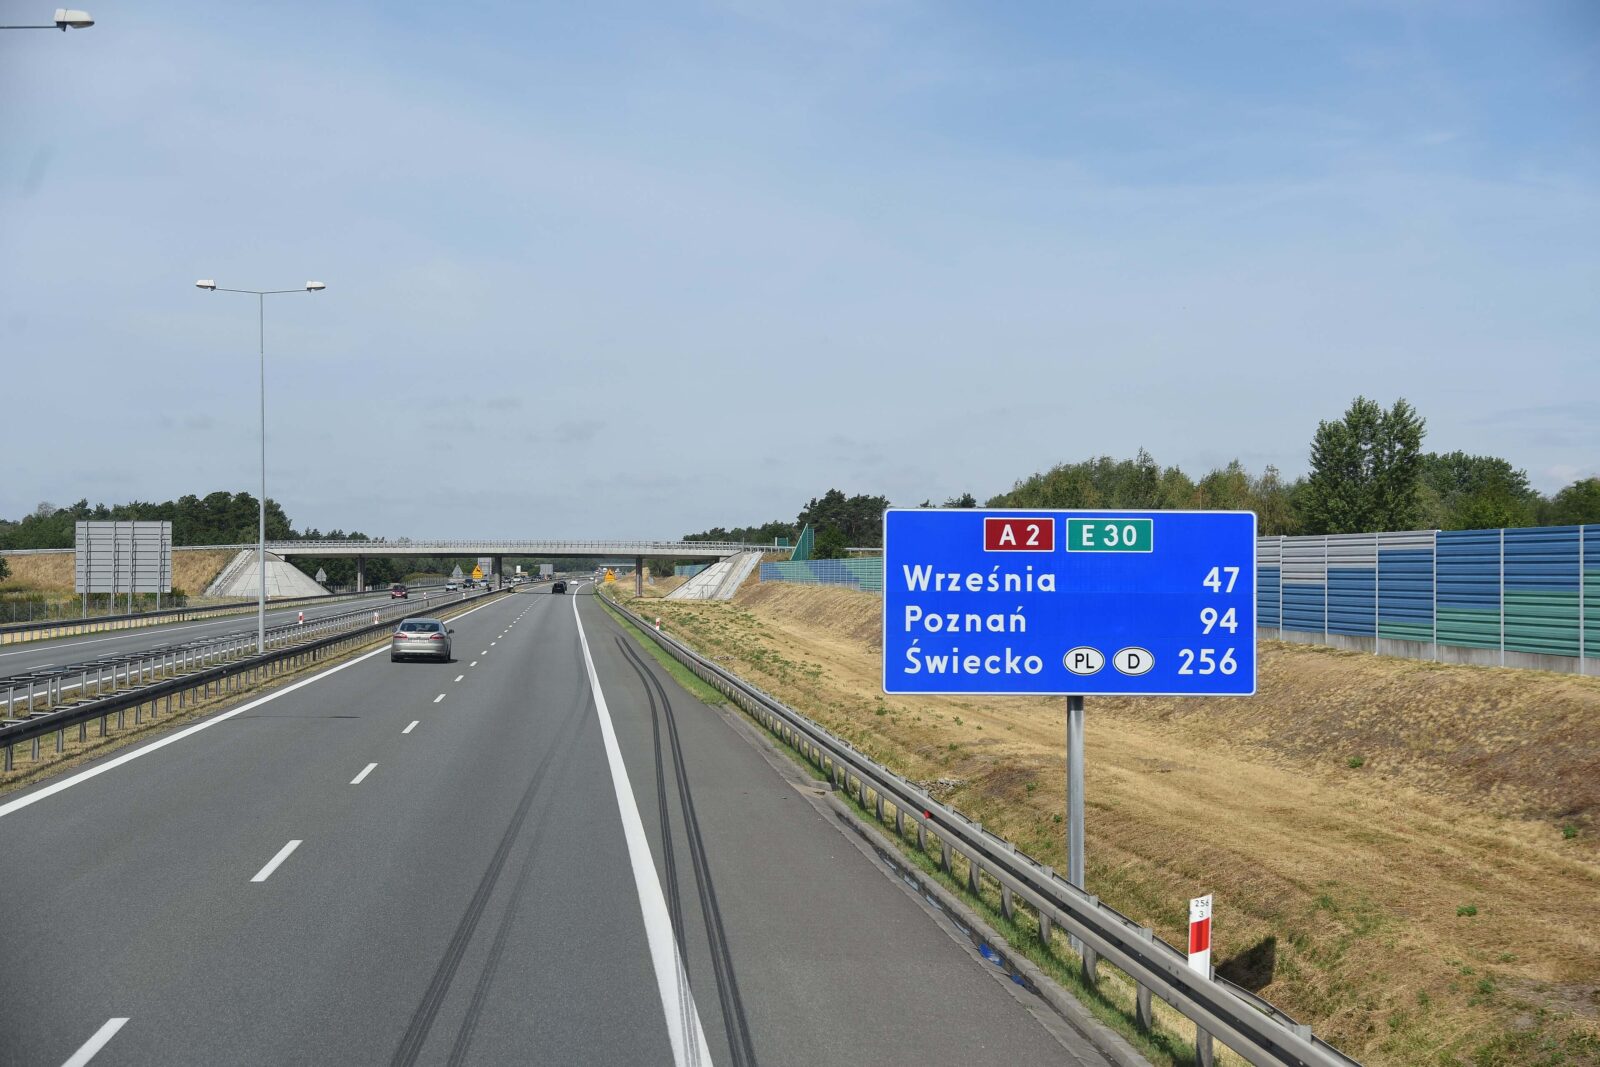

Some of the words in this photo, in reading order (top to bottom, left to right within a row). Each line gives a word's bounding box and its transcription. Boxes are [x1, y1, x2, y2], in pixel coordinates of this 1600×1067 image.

[999, 524, 1017, 546] A
[1026, 524, 1040, 546] 2
[1082, 525, 1095, 546] E
[1103, 525, 1137, 546] 30
[903, 564, 1056, 592] Września
[1202, 566, 1240, 593] 47
[905, 605, 1026, 633] Poznań
[1200, 607, 1239, 634] 94
[904, 638, 1043, 675] Świecko
[1075, 653, 1095, 669] PL
[1128, 653, 1141, 669] D
[1178, 647, 1238, 675] 256
[1195, 899, 1209, 907] 256
